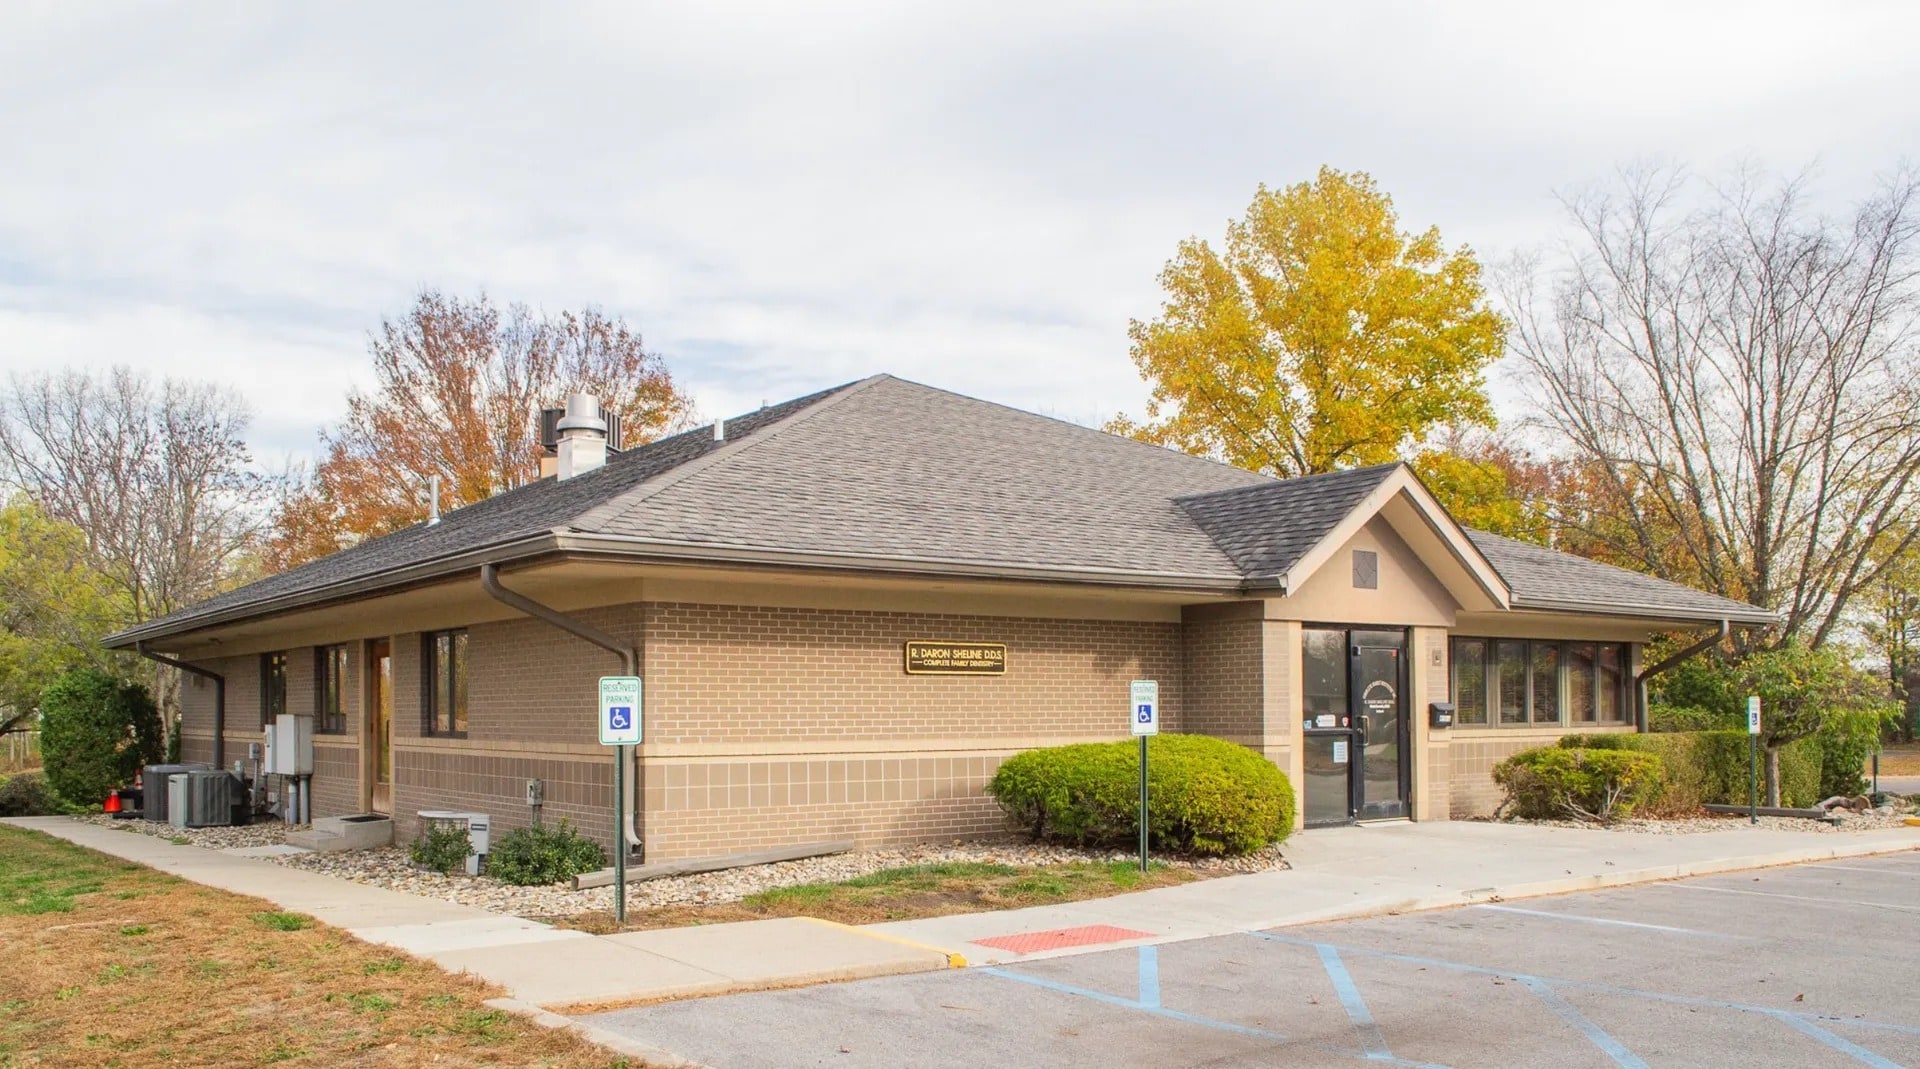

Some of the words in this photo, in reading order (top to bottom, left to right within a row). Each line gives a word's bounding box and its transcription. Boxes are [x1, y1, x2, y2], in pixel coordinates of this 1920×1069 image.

[911, 648, 918, 658] R.
[921, 648, 950, 659] DARON
[952, 649, 982, 659] SHELINE
[923, 659, 950, 667] COMPLETE
[603, 684, 637, 692] RESERVED
[605, 695, 633, 703] PARKING
